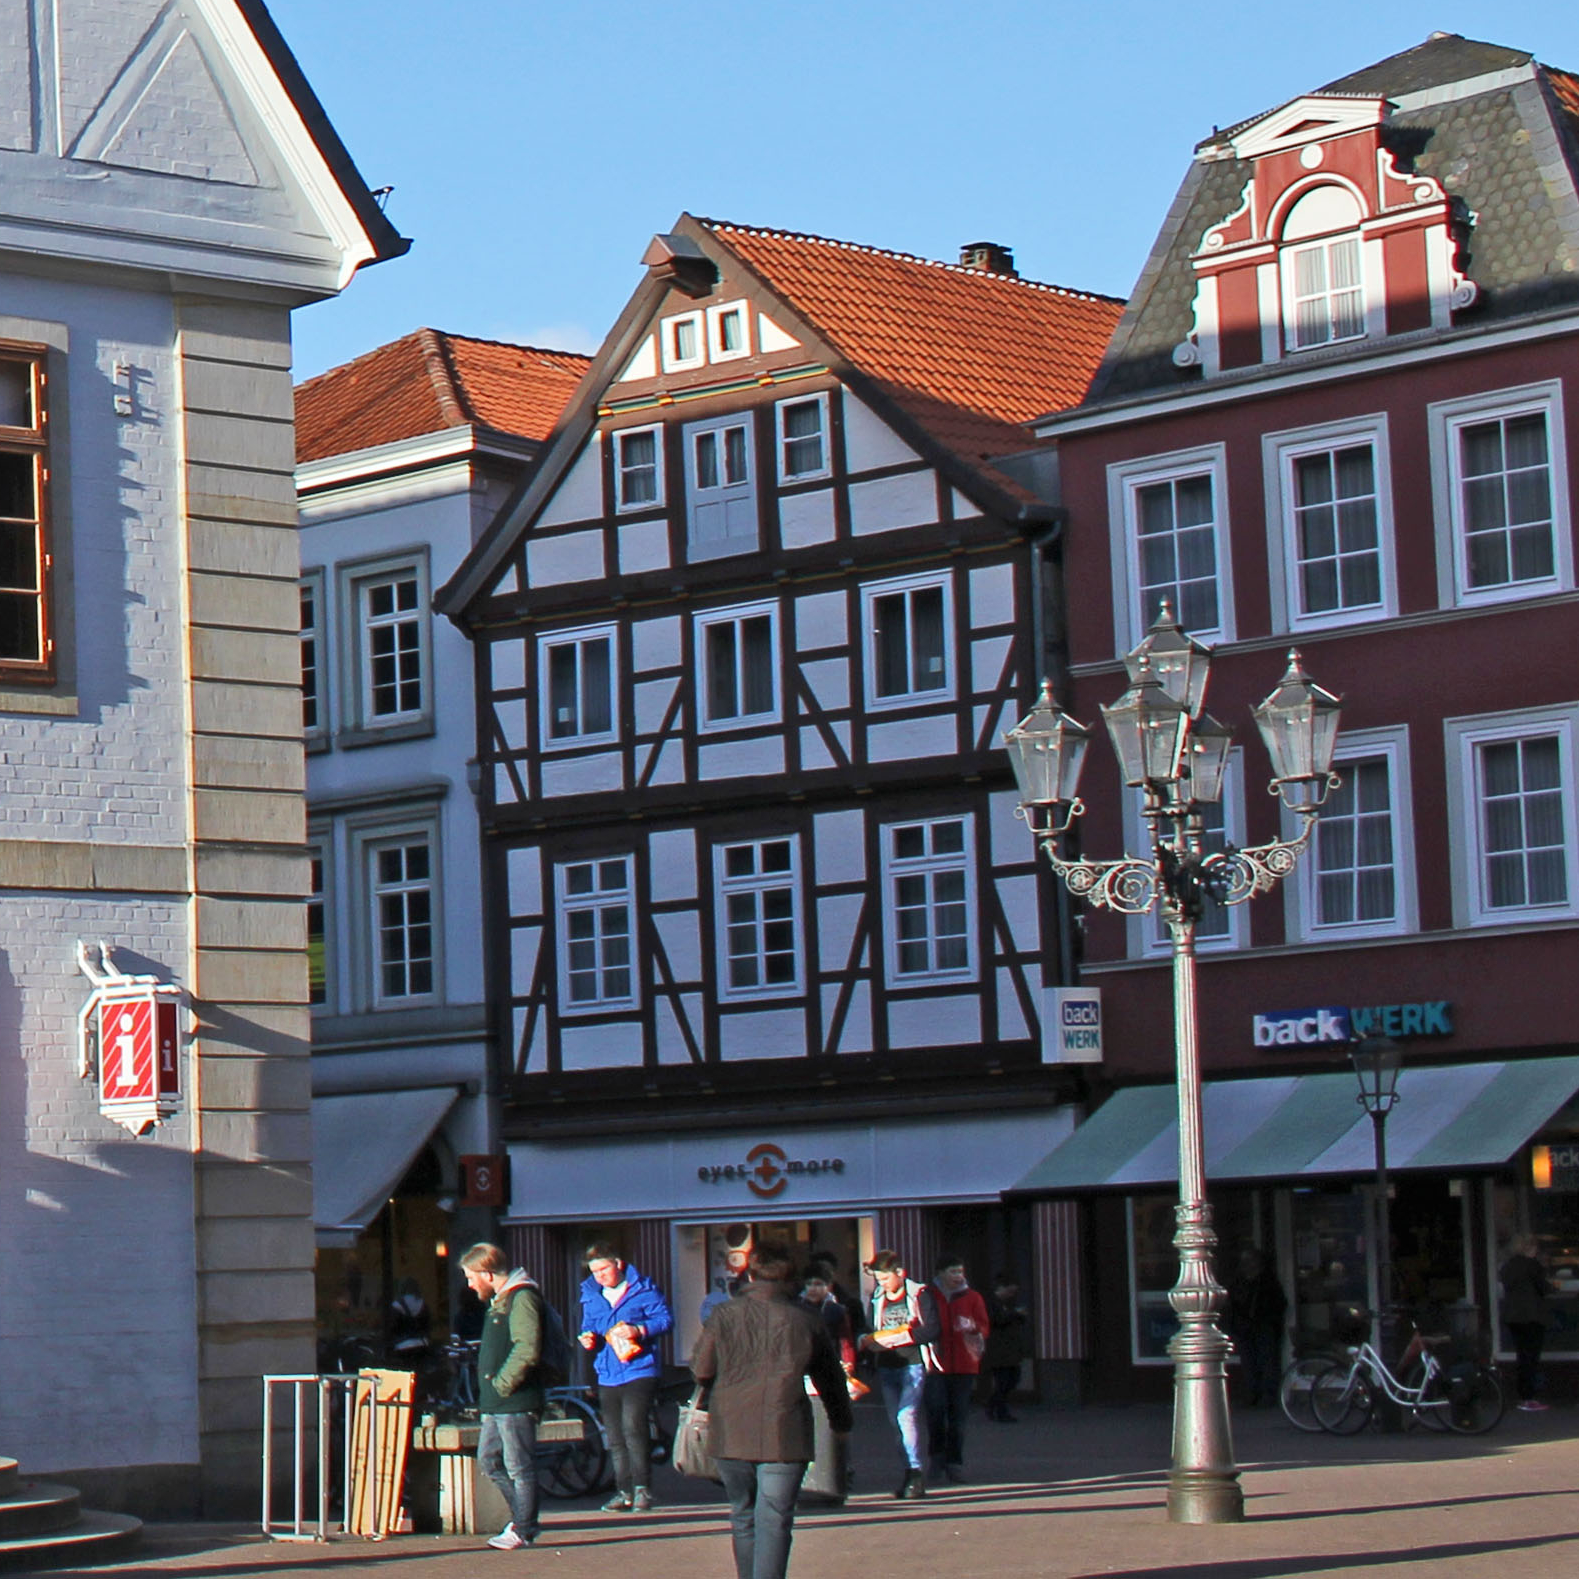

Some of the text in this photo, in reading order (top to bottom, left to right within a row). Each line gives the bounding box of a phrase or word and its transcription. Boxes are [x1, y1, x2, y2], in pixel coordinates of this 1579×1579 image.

[1064, 1003, 1098, 1024] back
[1253, 1000, 1454, 1047] back WERK
[1063, 1029, 1100, 1049] WERK
[787, 1158, 846, 1174] more
